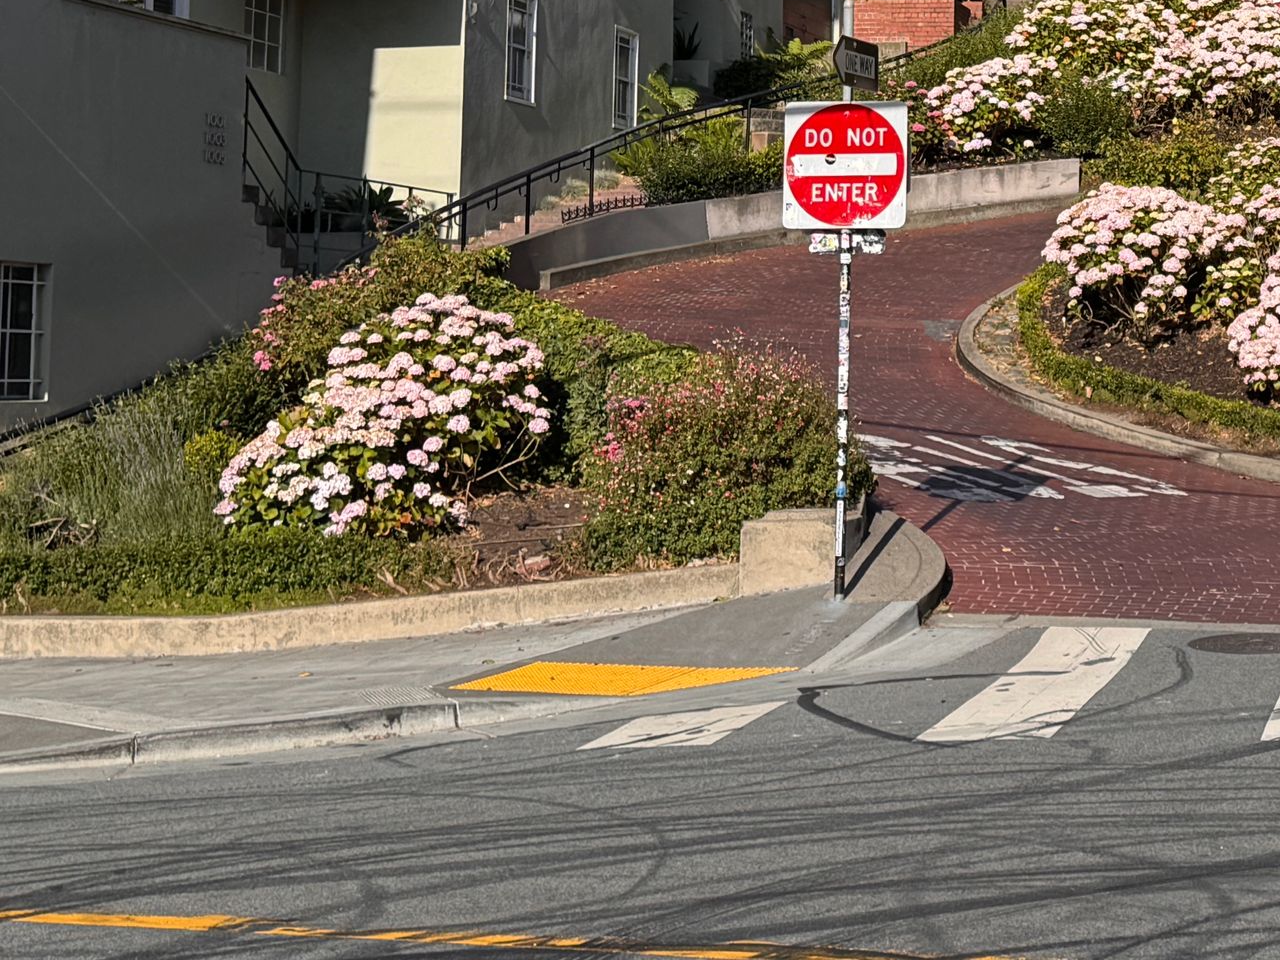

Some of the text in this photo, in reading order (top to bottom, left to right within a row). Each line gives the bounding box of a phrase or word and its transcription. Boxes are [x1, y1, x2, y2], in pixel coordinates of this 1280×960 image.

[845, 51, 874, 76] ONE WAY
[804, 127, 888, 148] DO NOT
[811, 182, 878, 203] ENTER
